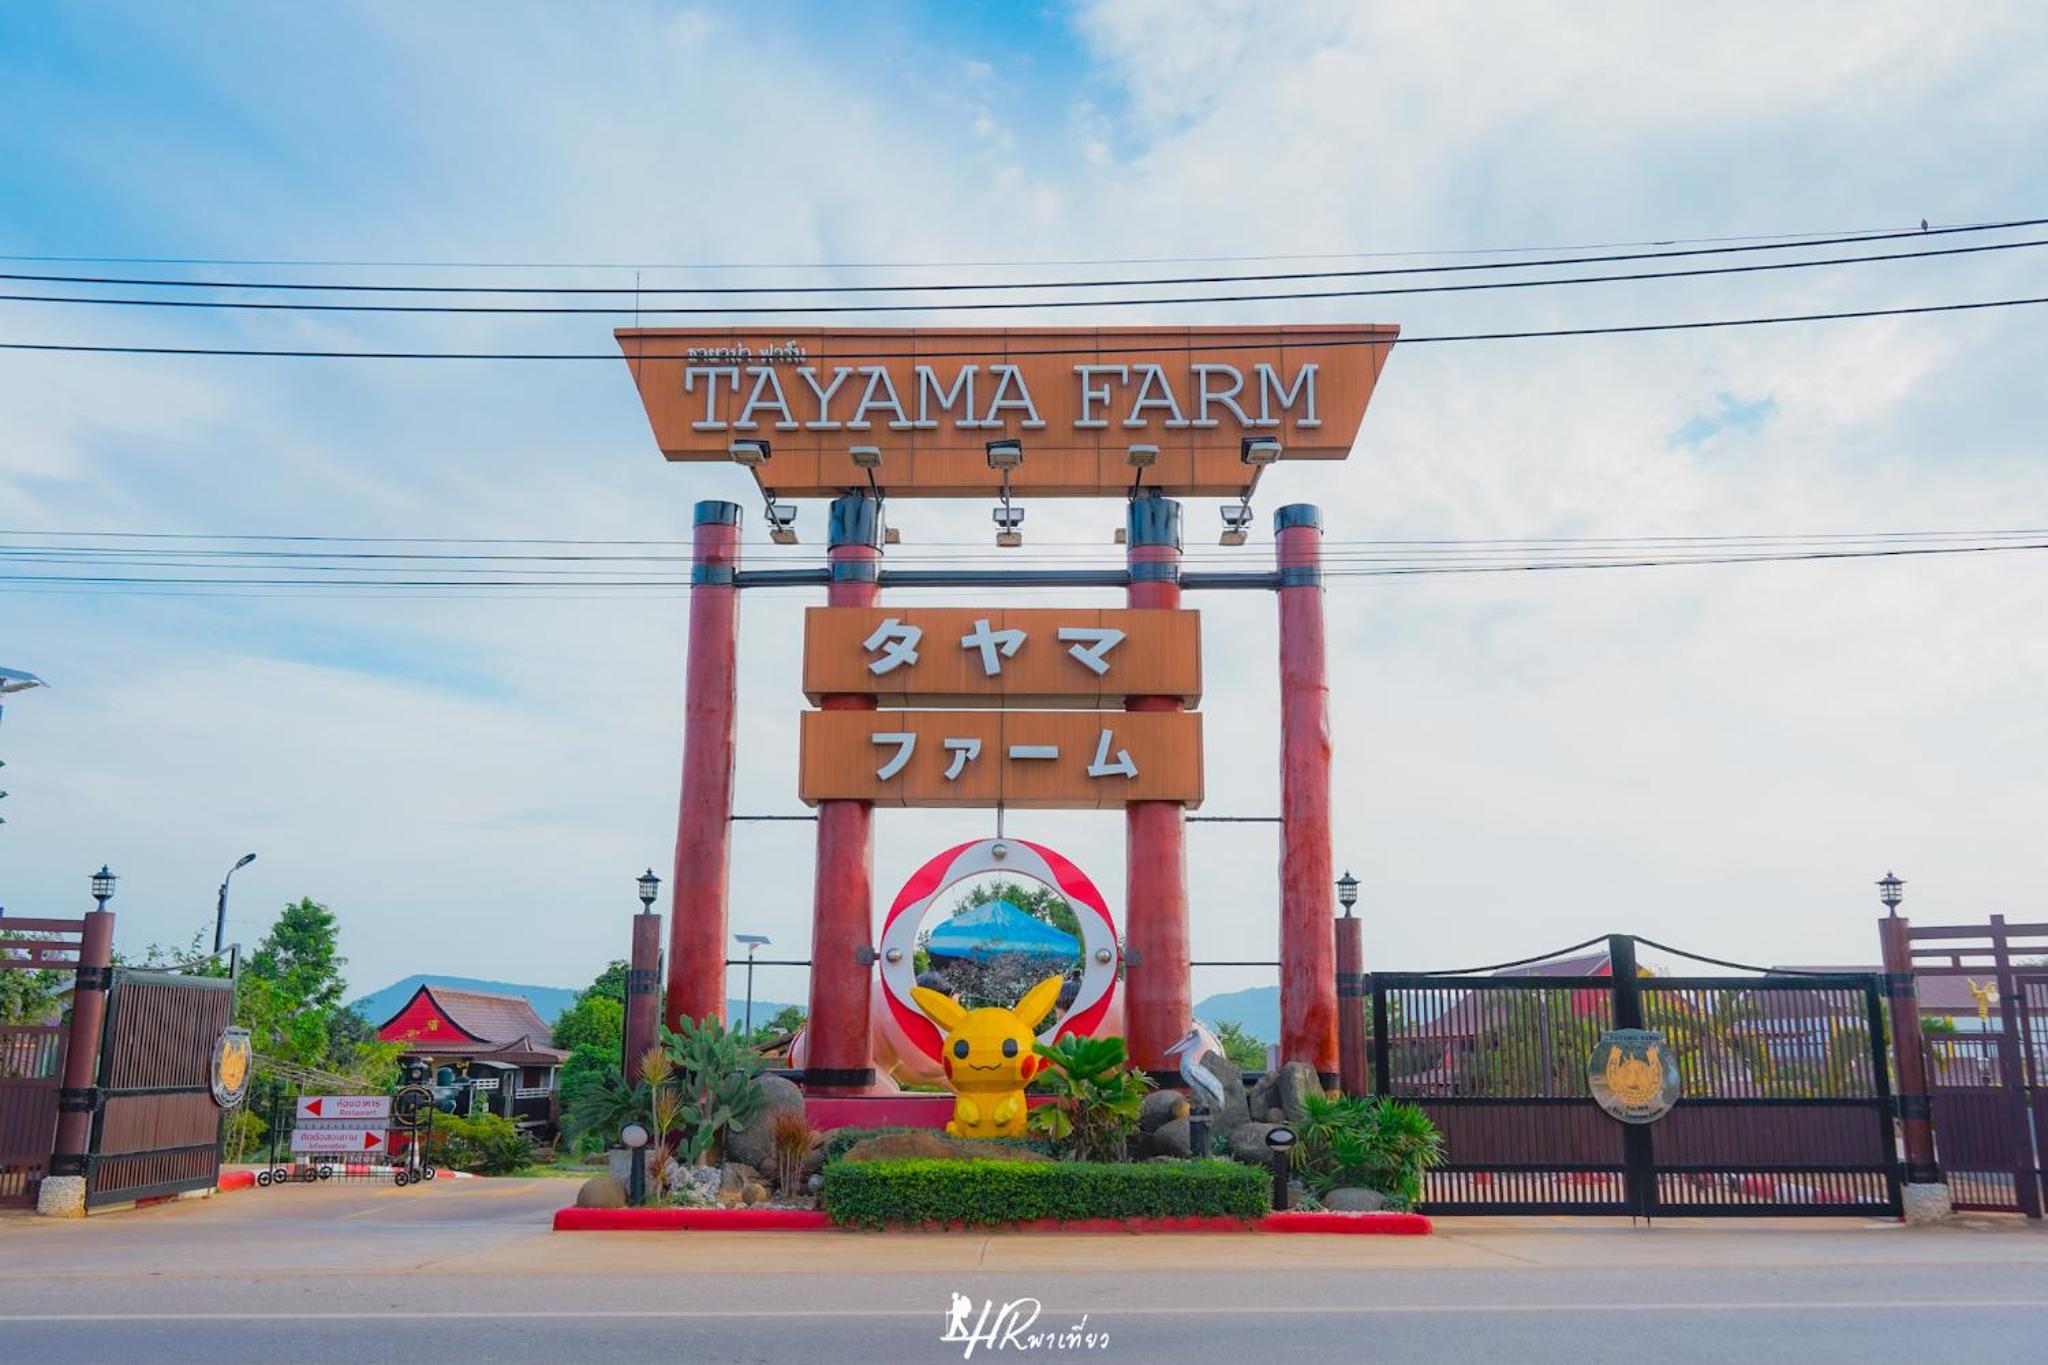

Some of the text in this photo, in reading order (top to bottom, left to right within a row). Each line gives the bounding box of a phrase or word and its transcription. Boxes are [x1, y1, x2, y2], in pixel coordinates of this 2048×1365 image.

[684, 363, 1322, 430] TAYAMA FARM
[862, 618, 1127, 677] タヤマ
[871, 728, 1139, 781] ファーム
